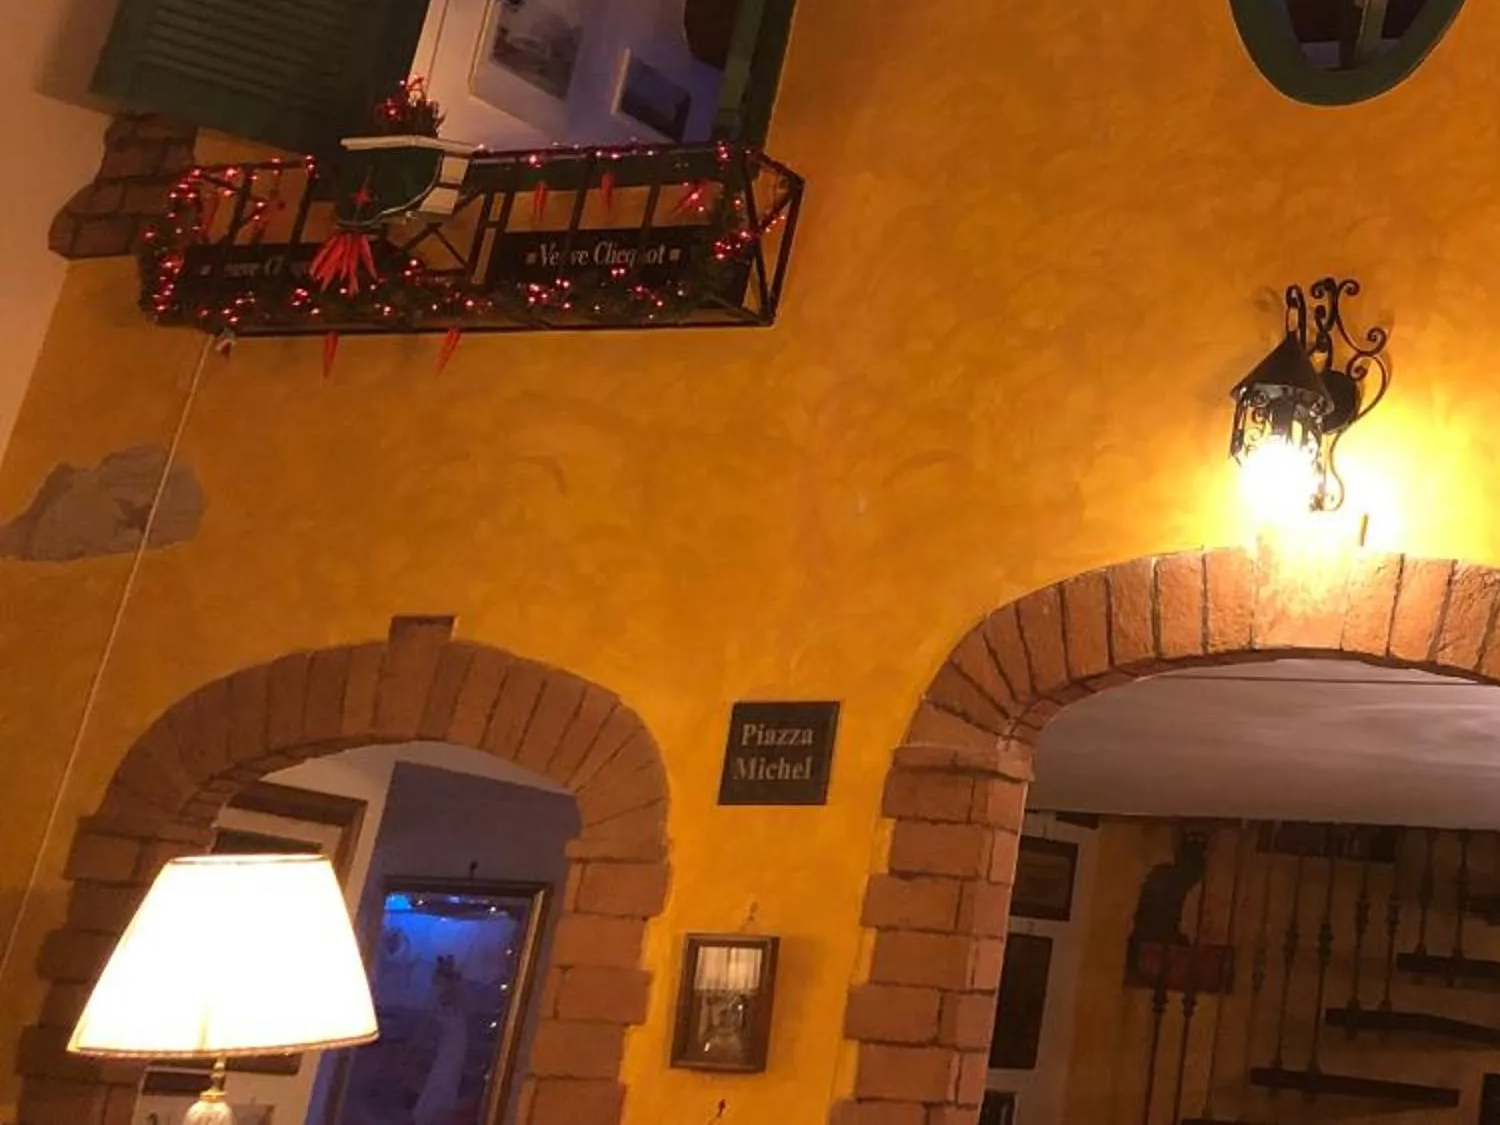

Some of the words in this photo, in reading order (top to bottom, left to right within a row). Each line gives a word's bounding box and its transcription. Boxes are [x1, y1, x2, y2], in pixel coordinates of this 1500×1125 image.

[540, 241, 589, 268] Veve
[593, 239, 666, 268] Clicqot
[741, 723, 813, 746] Piazza
[733, 756, 812, 780] Michel
